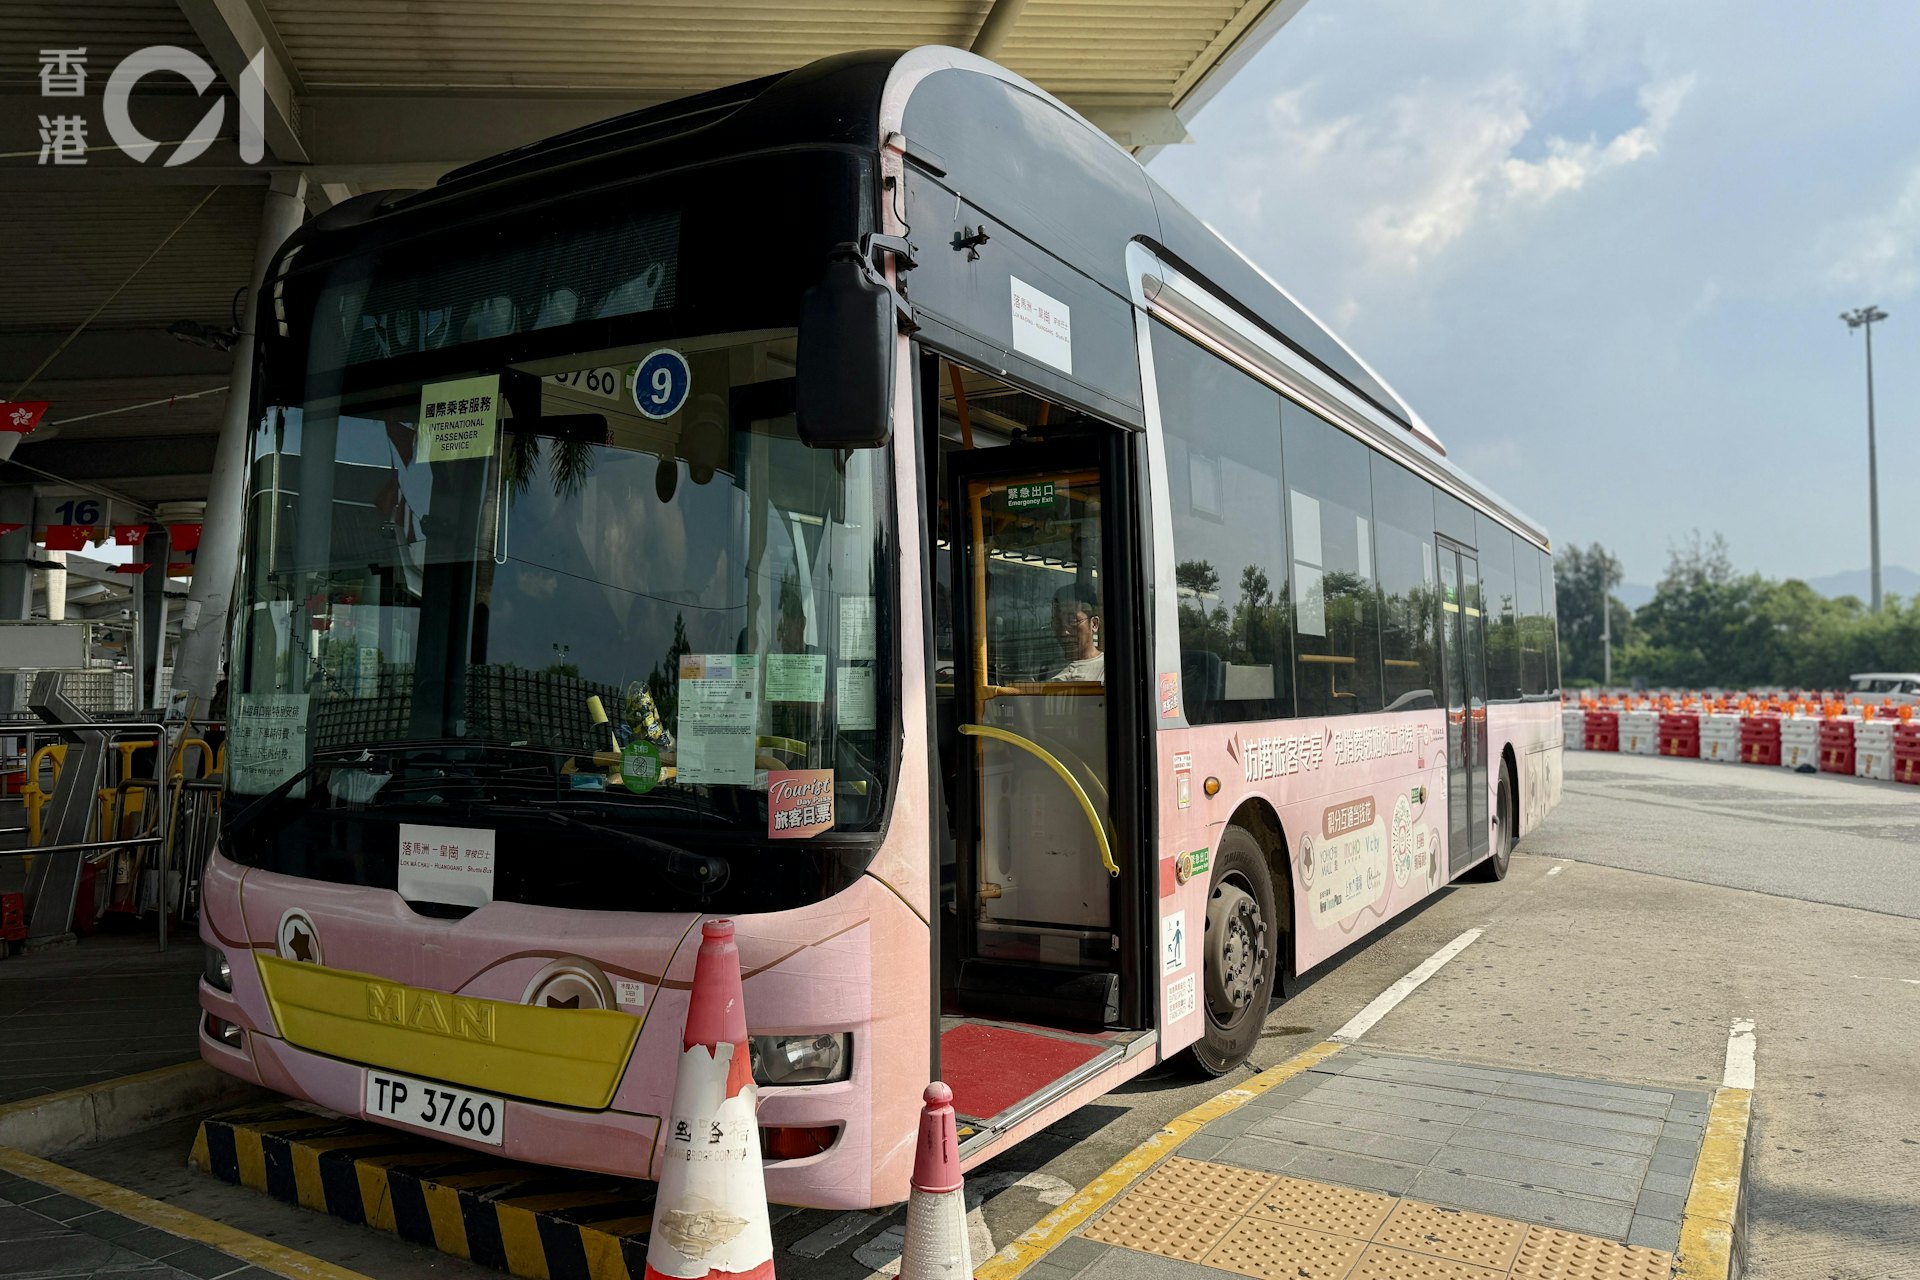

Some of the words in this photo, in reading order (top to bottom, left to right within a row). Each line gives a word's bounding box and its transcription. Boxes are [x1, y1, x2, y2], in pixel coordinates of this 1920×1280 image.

[651, 368, 672, 404] 9
[426, 396, 492, 418] 國際乘客服務
[429, 418, 485, 433] INTERNATIONAL
[435, 430, 479, 443] PASSENGER
[441, 441, 470, 451] SERVICE
[1008, 485, 1053, 500] 緊急出口
[1008, 498, 1040, 507] Emergency
[55, 500, 99, 526] 16
[770, 778, 831, 804] Tourist
[797, 798, 811, 807] Day
[774, 803, 832, 830] 旅客日票
[464, 849, 491, 859] 穿梭巴士
[400, 859, 410, 867] LOK
[434, 862, 463, 872] HUANGGANG
[366, 983, 496, 1042] MAN
[374, 1077, 408, 1114] TP
[420, 1088, 495, 1137] 3760
